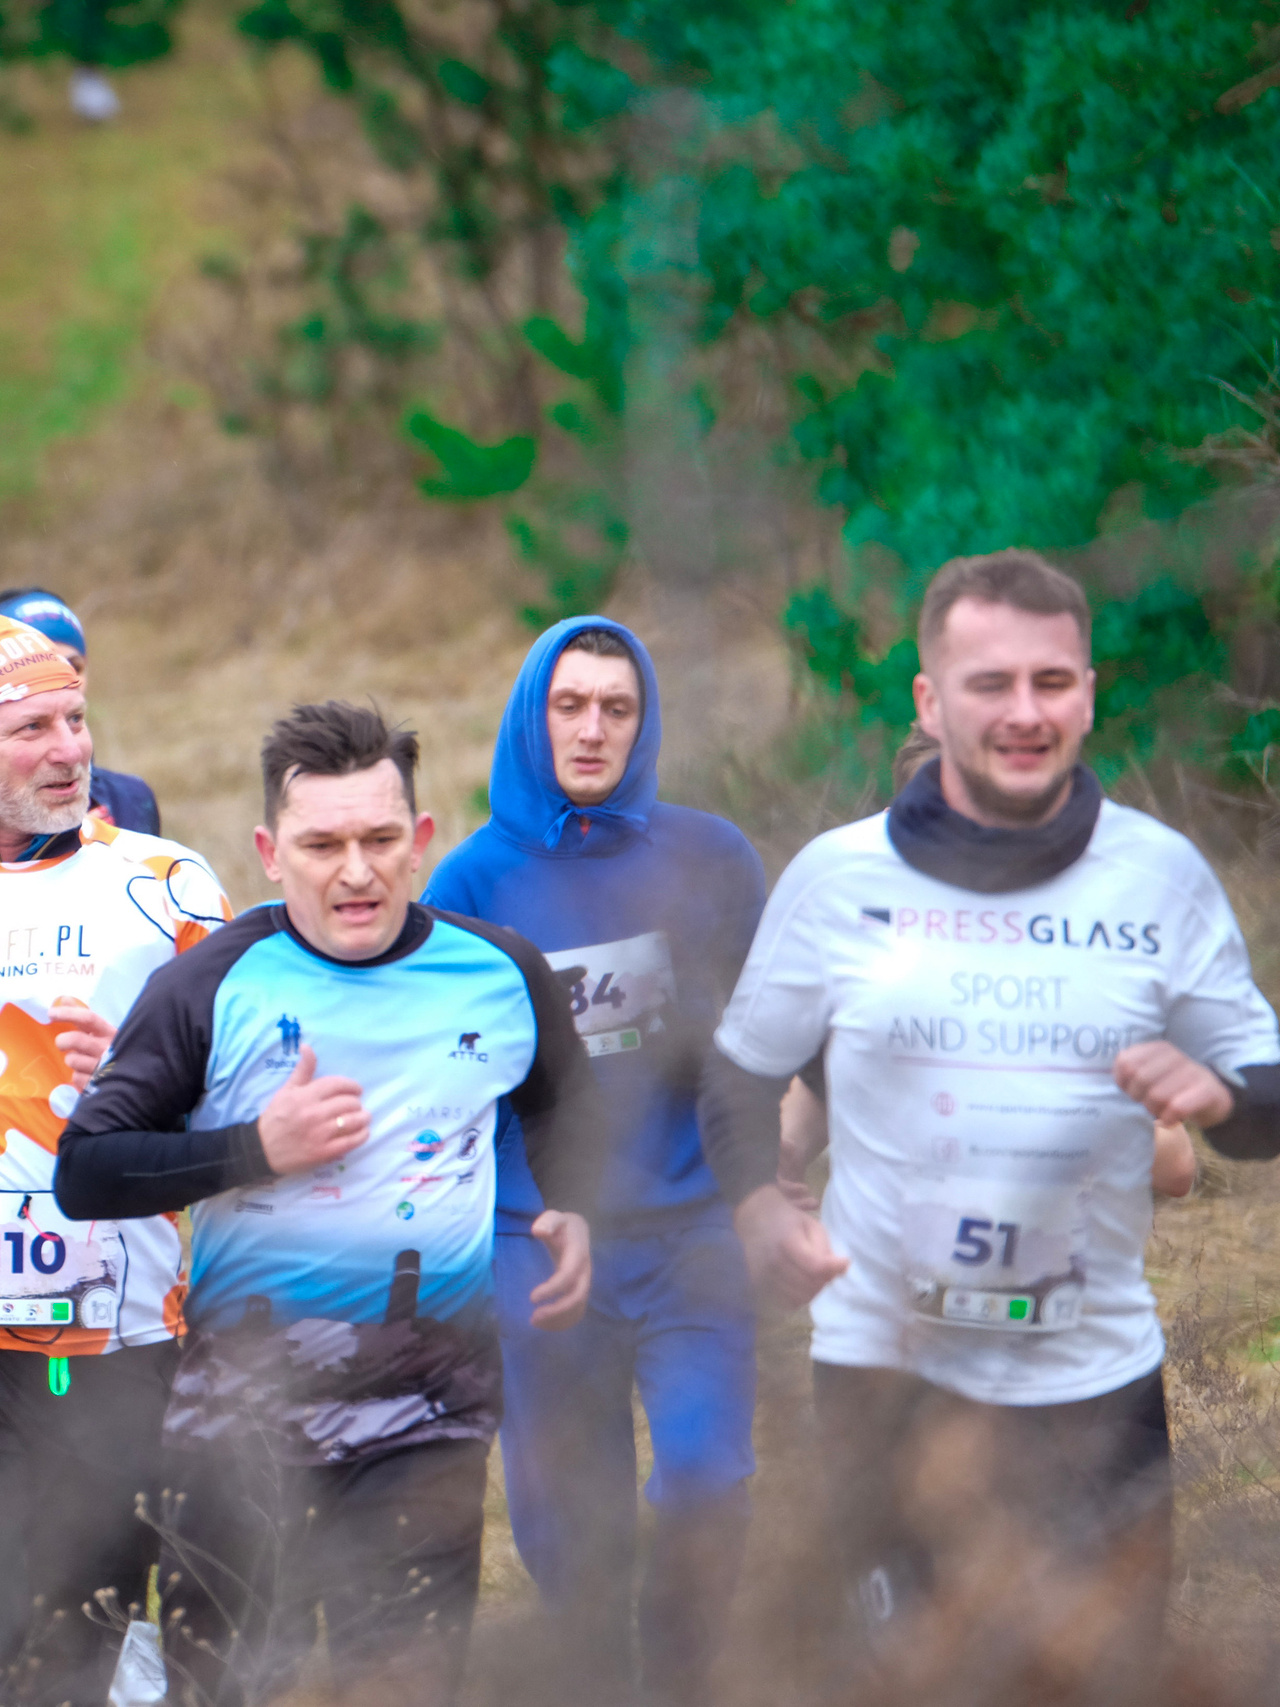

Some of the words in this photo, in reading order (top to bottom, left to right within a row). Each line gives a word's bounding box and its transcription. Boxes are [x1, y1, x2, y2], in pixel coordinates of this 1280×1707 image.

[896, 906, 1162, 955] PRESSGLASS
[43, 961, 95, 976] TEAM
[950, 971, 1068, 1011] SPORT
[888, 1015, 968, 1053] AND
[952, 1217, 1020, 1267] 51
